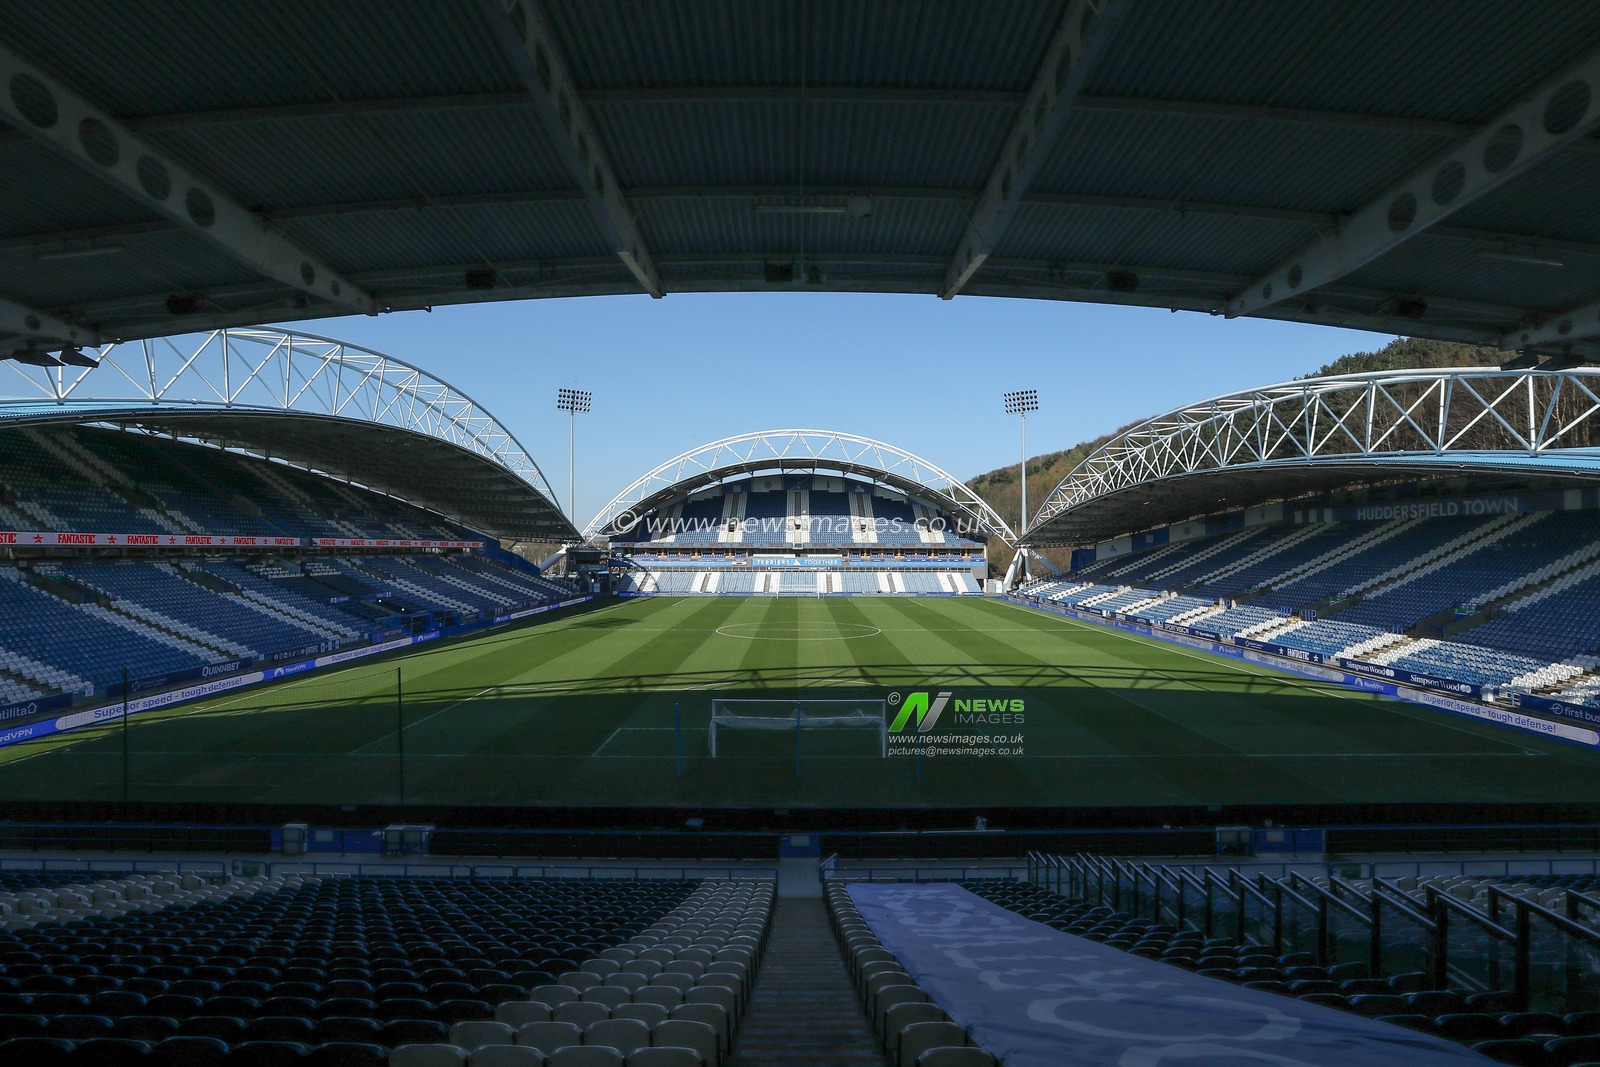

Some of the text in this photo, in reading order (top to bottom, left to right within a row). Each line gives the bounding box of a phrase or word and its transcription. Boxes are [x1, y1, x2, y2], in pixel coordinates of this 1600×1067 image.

[1357, 497, 1518, 521] HUDDERSFIELD TOWN
[57, 533, 96, 544] FANTASTIC
[127, 535, 159, 545] FANTASTIC
[185, 536, 212, 545] FANTASTIC
[233, 537, 256, 545] FANTASTIC
[1287, 648, 1310, 661] FANTASTIC
[202, 662, 240, 677] QUINNBET
[1346, 661, 1386, 676] Simpson Wood
[1363, 681, 1384, 691] NordVPN
[1410, 674, 1460, 692] Simpson Wood
[143, 693, 173, 709] speed
[181, 686, 207, 699] tough
[208, 678, 242, 692] defense!
[0, 706, 27, 720] tilita
[1422, 693, 1454, 708] Superior
[1456, 704, 1480, 715] speed
[1488, 710, 1513, 723] tough
[1515, 717, 1557, 733] defense!
[1564, 706, 1600, 722] first bus
